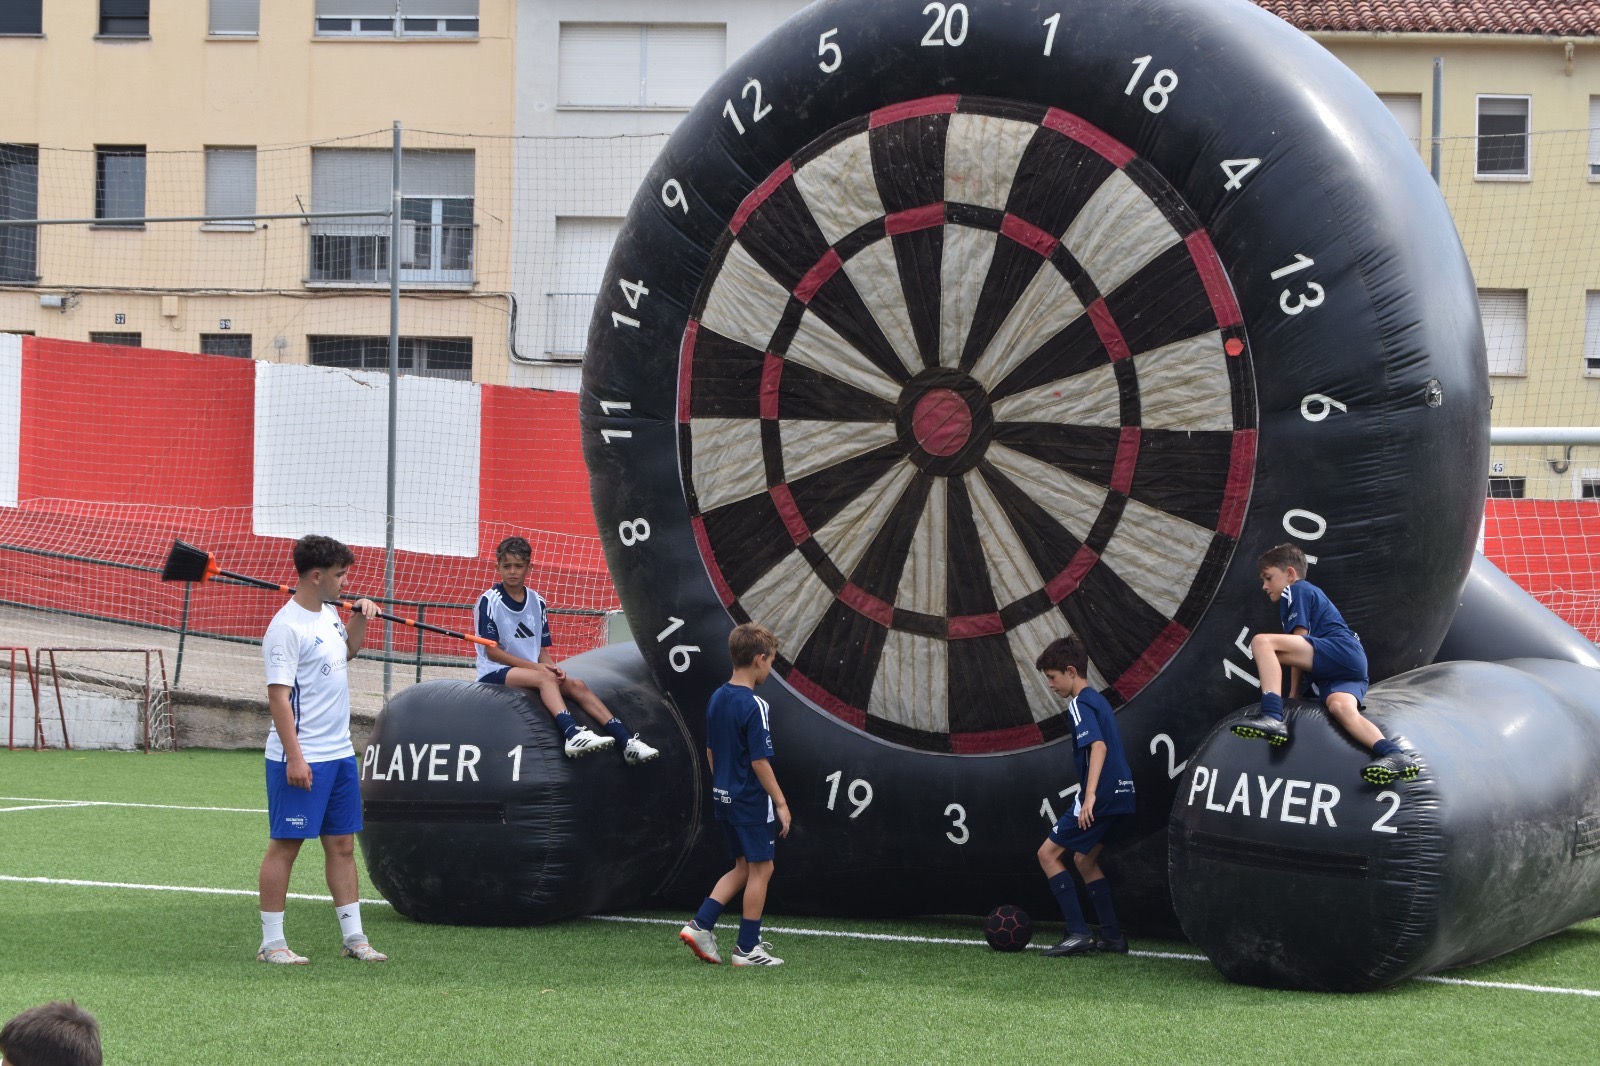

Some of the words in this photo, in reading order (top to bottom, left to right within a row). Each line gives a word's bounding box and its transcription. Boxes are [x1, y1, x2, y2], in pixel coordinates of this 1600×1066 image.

[921, 2, 969, 47] 20
[1042, 12, 1061, 57] 1
[818, 27, 843, 73] 5
[722, 77, 773, 135] 12
[1124, 54, 1179, 114] 18
[661, 178, 689, 215] 9
[1219, 157, 1262, 192] 4
[611, 278, 650, 329] 14
[1270, 253, 1326, 316] 13
[599, 400, 633, 444] 11
[1300, 393, 1348, 423] 6
[1492, 463, 1503, 472] 45
[618, 517, 651, 547] 8
[656, 616, 701, 673] 16
[361, 743, 482, 782] PLAYER
[507, 744, 523, 782] 1
[1149, 733, 1188, 780] 2
[825, 770, 873, 818] 19
[1187, 765, 1341, 828] PLAYER
[1371, 790, 1401, 834] 2
[943, 803, 970, 845] 3
